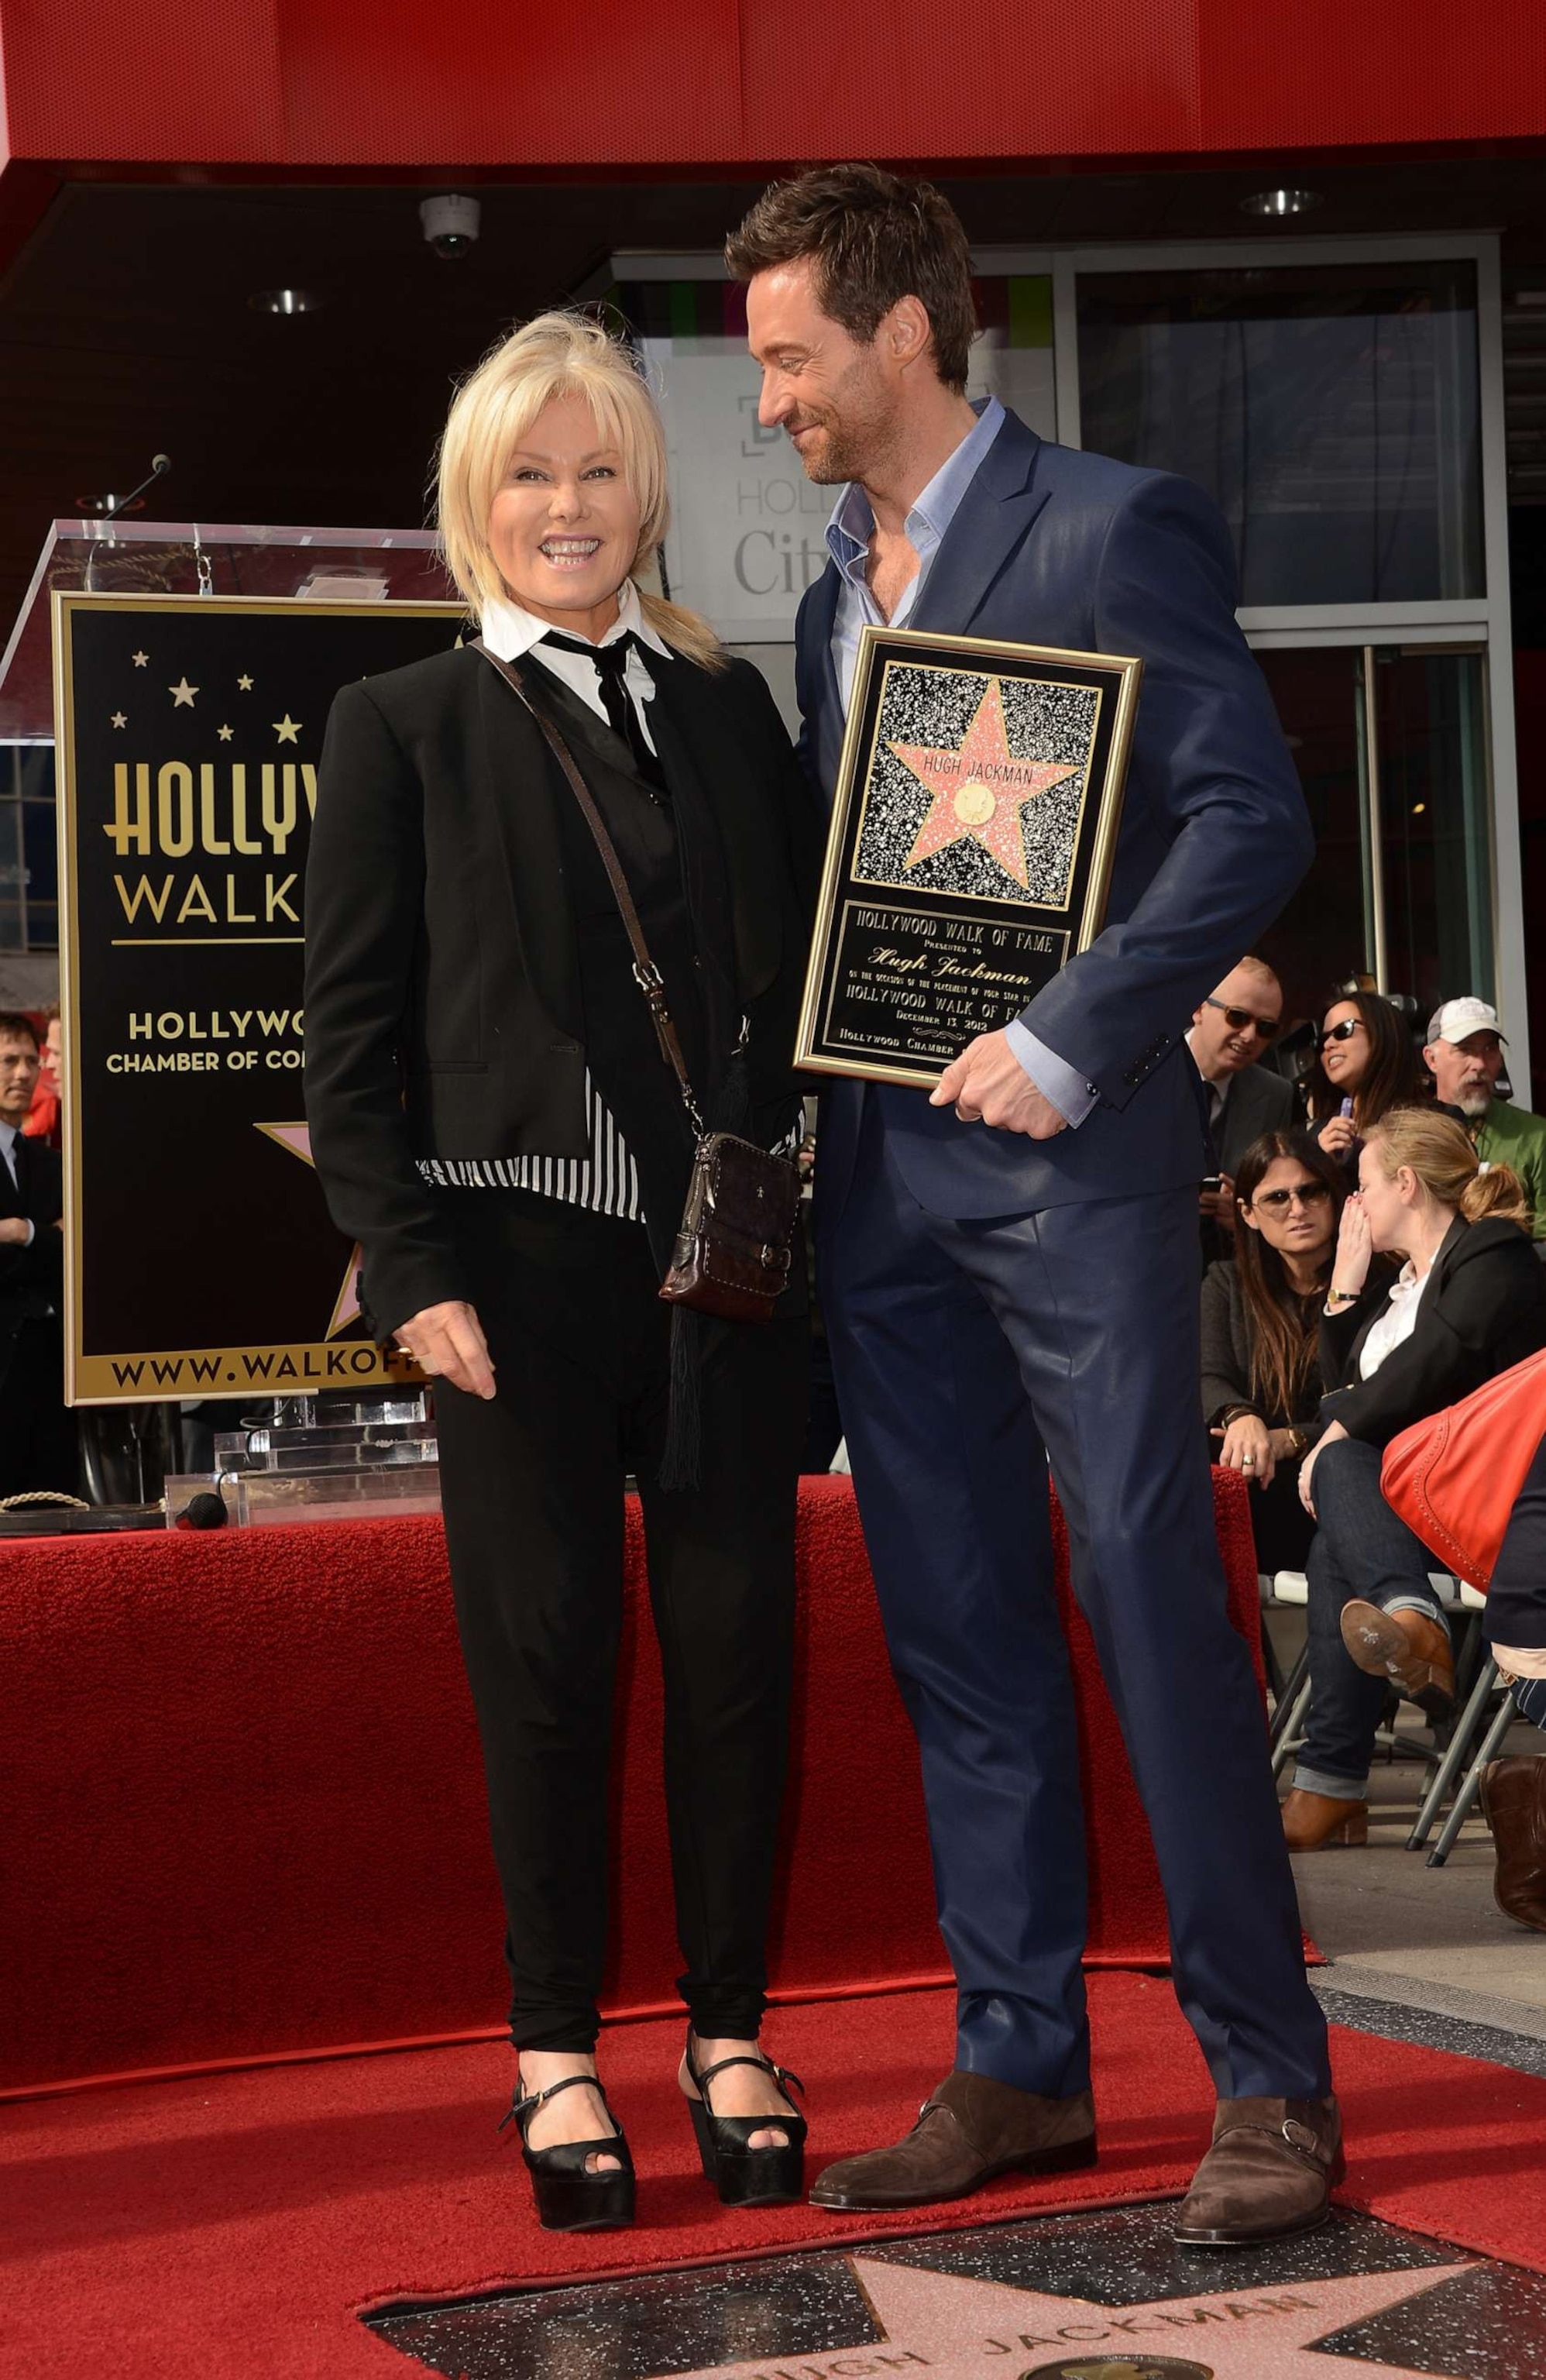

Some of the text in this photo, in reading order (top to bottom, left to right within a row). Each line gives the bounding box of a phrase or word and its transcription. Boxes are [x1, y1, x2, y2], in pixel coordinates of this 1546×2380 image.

[923, 755, 1034, 785] HUGH JACKMAN
[113, 873, 300, 924] WALK
[856, 910, 1054, 953] HOLLYWOOD WALK OF FAME
[867, 947, 1032, 985] Hugh Jackman
[846, 984, 926, 1009] HOLLYWOOD
[936, 997, 974, 1016] WALK
[981, 1003, 998, 1019] OF
[861, 972, 872, 982] THE
[876, 974, 905, 985] OCCASION
[908, 977, 916, 987] OF
[919, 979, 931, 989] THE
[933, 981, 967, 994] PLACEMENT
[971, 987, 979, 996] OF
[984, 989, 1000, 999] YOUR
[1003, 992, 1019, 1002] STAR
[964, 1020, 988, 1031] 2012
[106, 1050, 305, 1073] CHAMBER OF CO
[984, 2295, 1319, 2355] JACKMAN
